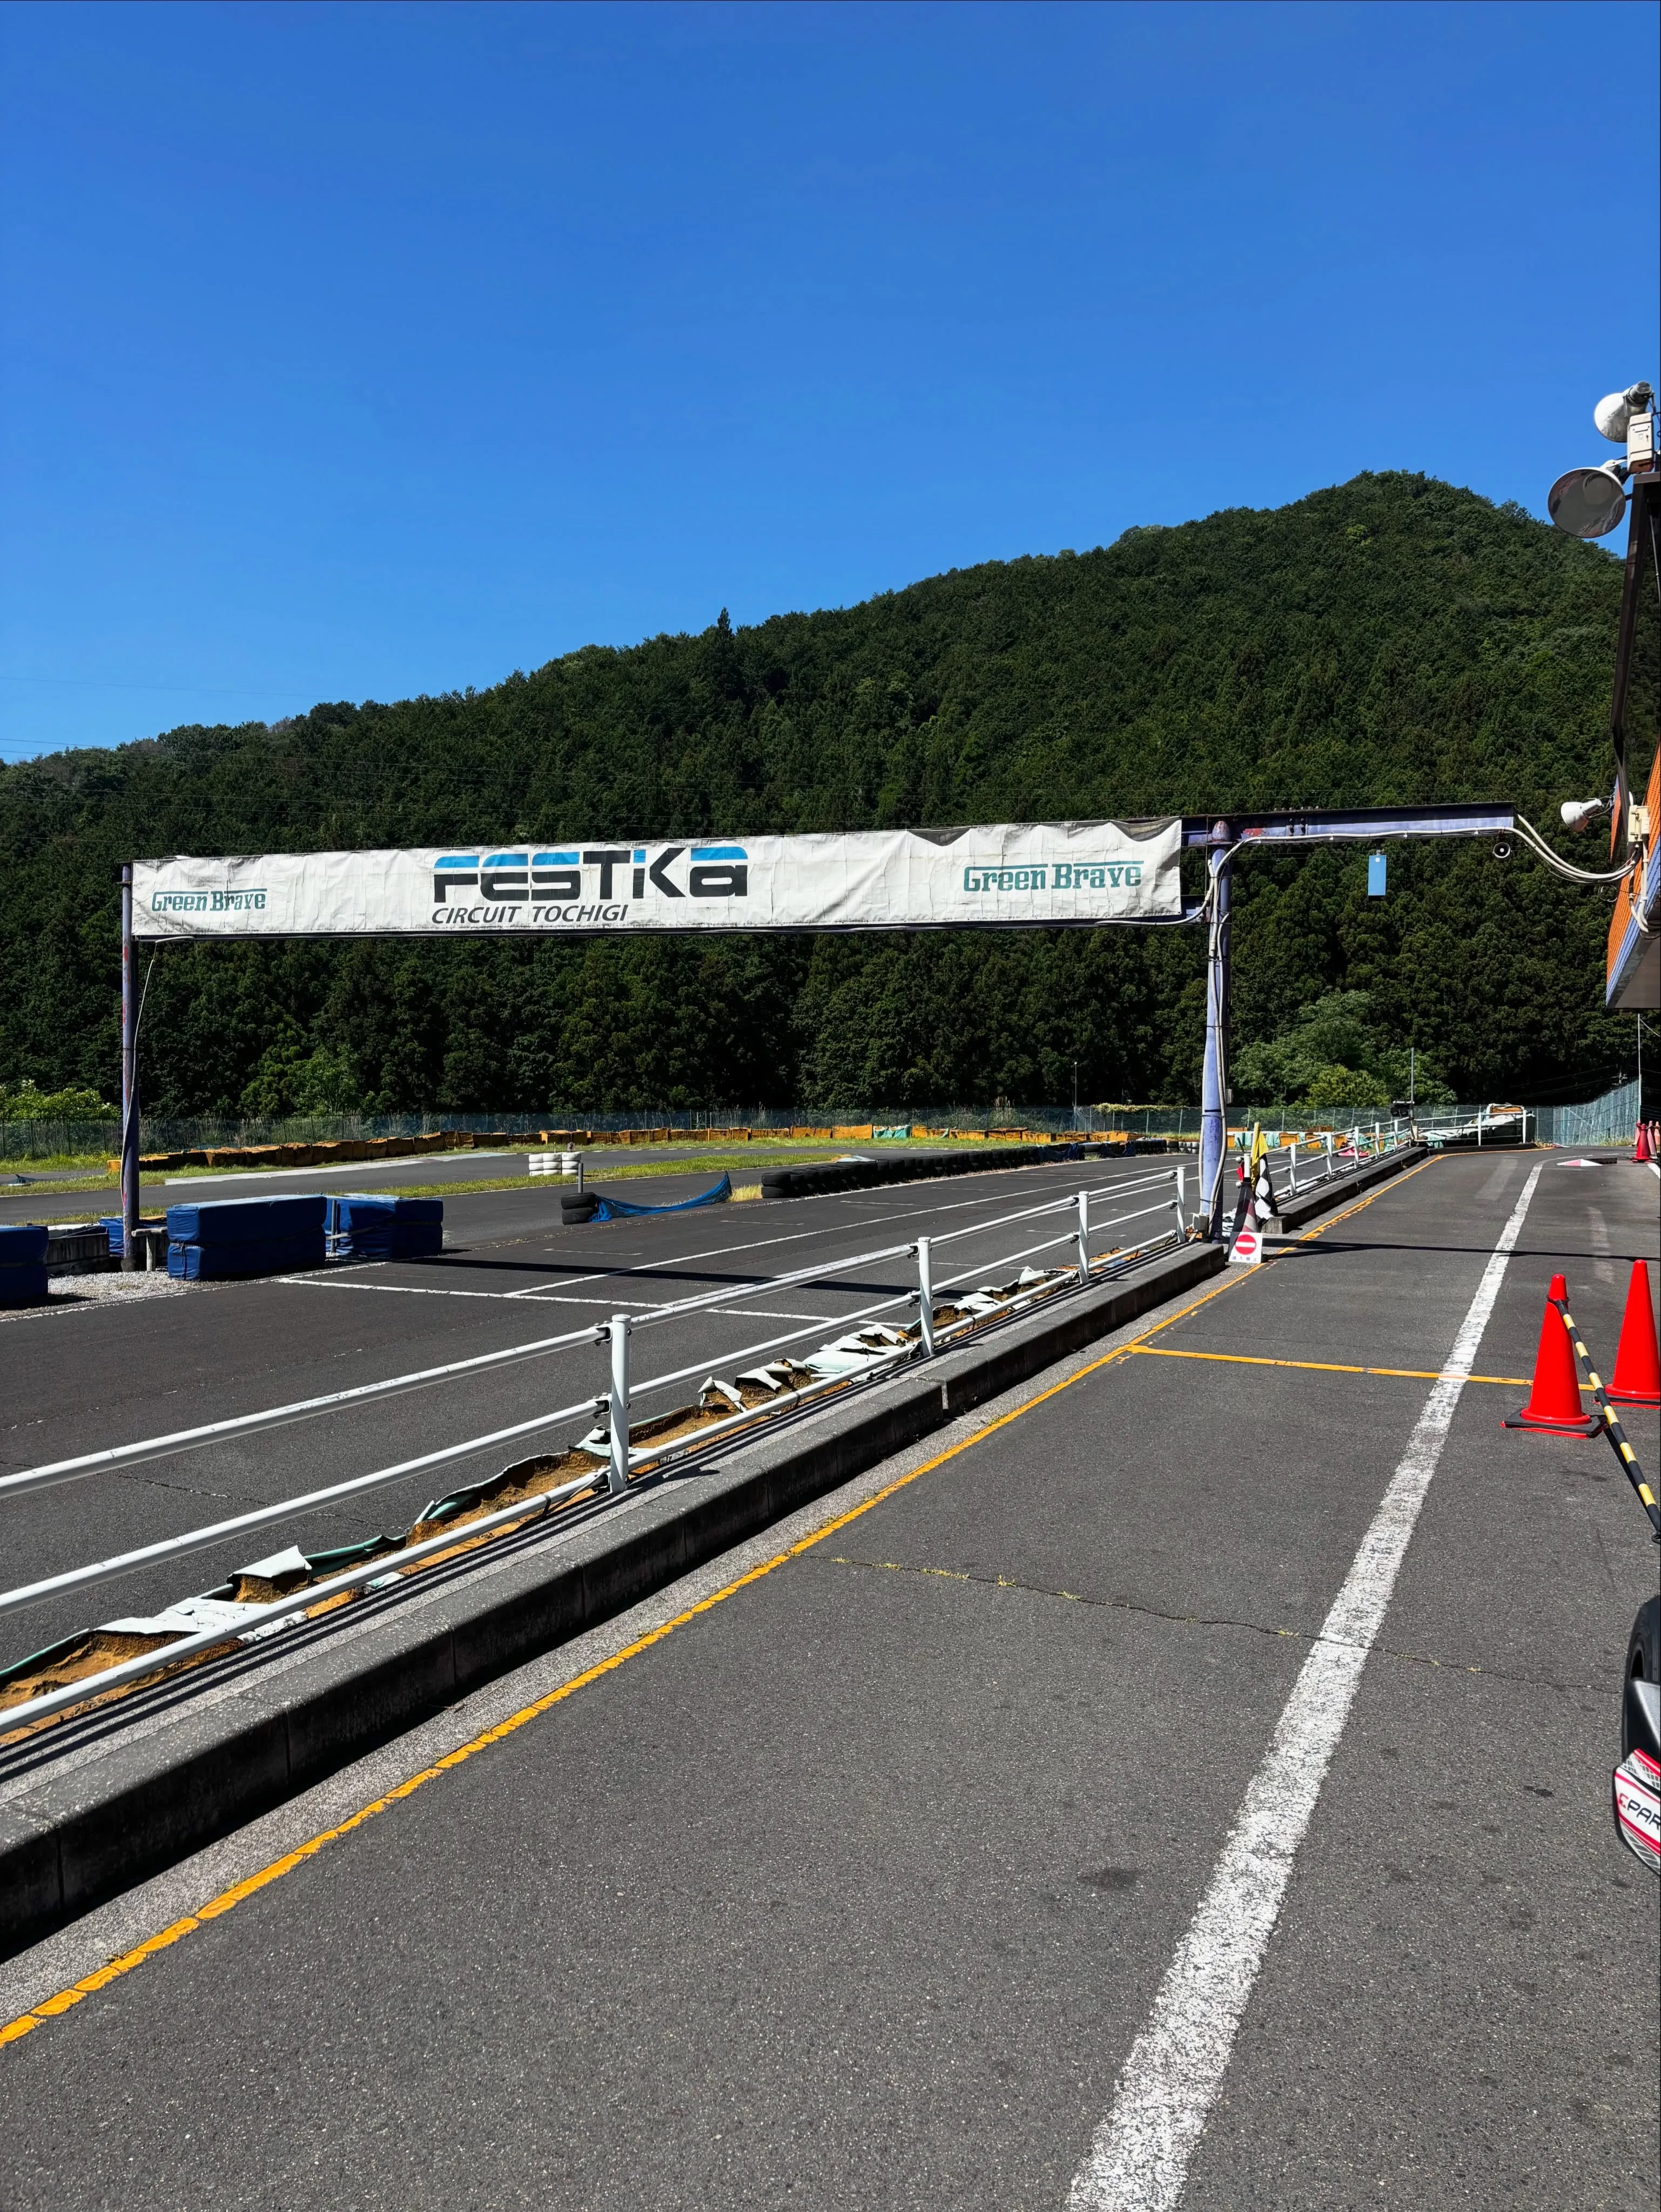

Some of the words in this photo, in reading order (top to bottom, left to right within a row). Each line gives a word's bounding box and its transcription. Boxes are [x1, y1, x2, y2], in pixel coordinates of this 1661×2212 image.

[964, 864, 1048, 892] Green
[1051, 860, 1144, 889] Brave
[152, 891, 209, 912] Green
[210, 888, 267, 911] Brave
[432, 906, 521, 924] CIRCUIT
[533, 904, 628, 922] TOCHIGI
